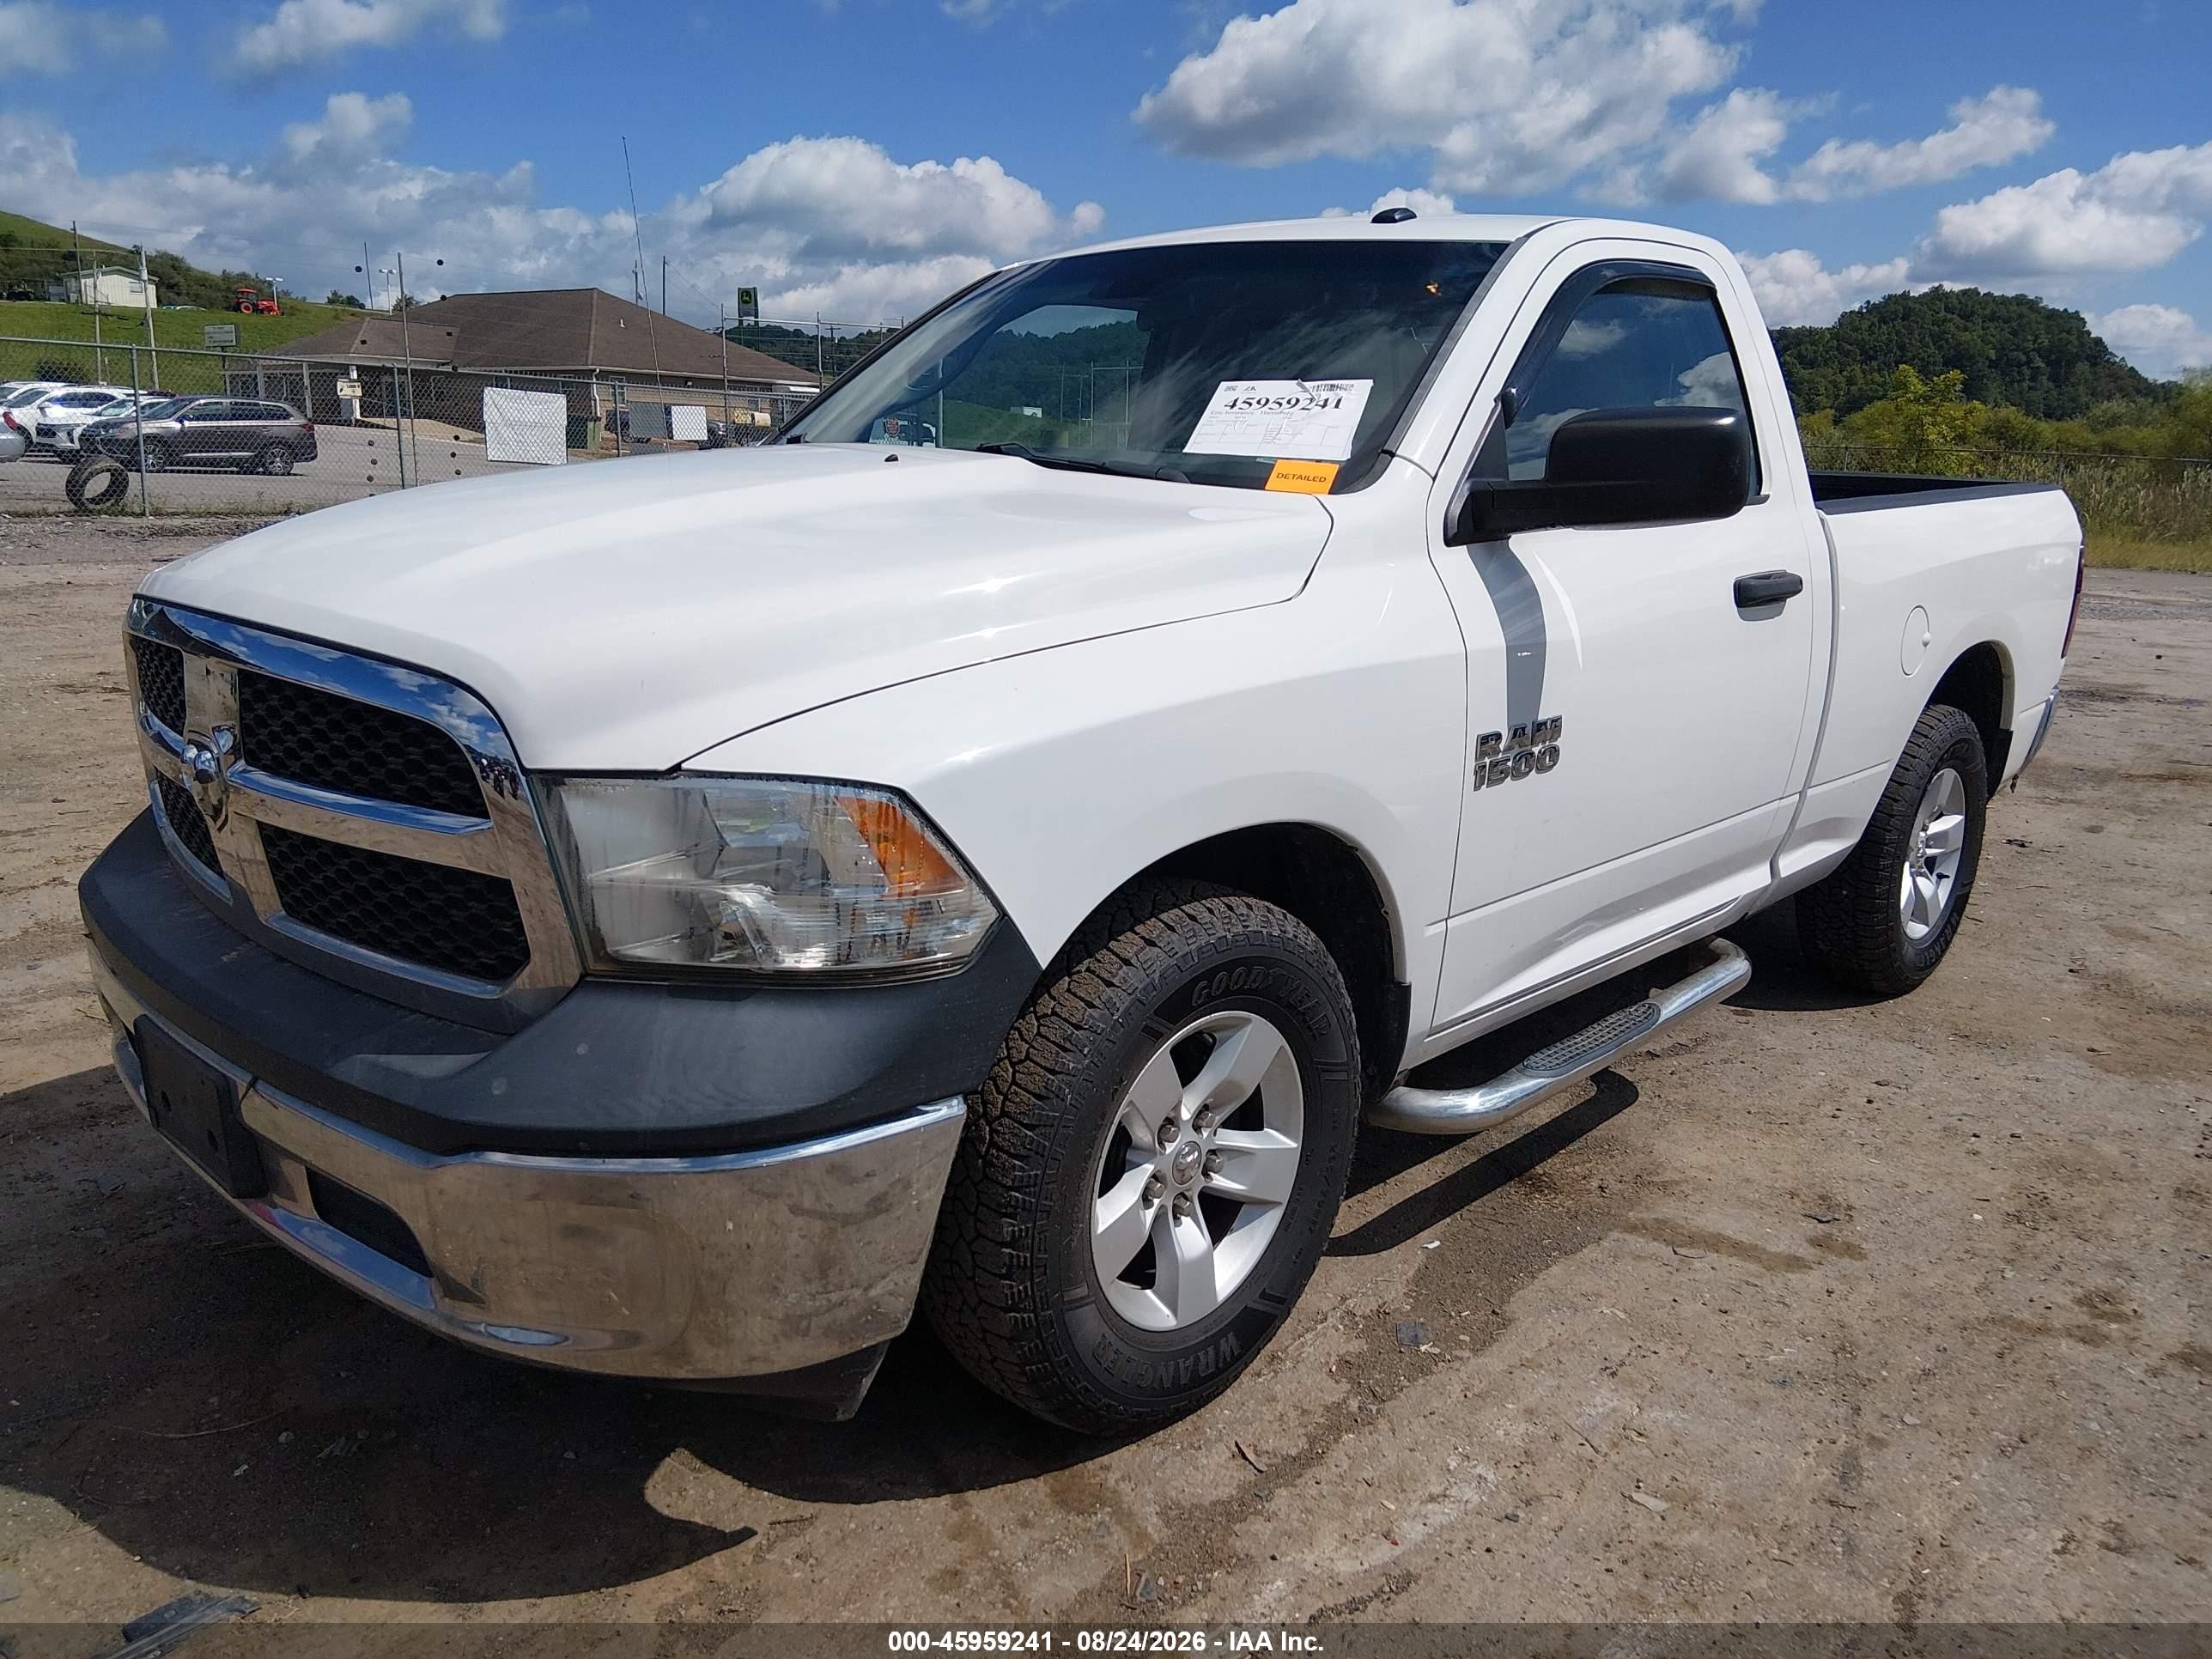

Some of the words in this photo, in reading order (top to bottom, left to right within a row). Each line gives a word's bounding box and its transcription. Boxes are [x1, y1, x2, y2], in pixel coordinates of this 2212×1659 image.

[1224, 396, 1343, 410] 45959241
[1276, 472, 1327, 483] DETAILED
[1474, 714, 1563, 763] RAM
[1474, 744, 1561, 792] 1500
[1192, 965, 1332, 1041] GOODYEAR
[1091, 1332, 1241, 1390] WRANGLER
